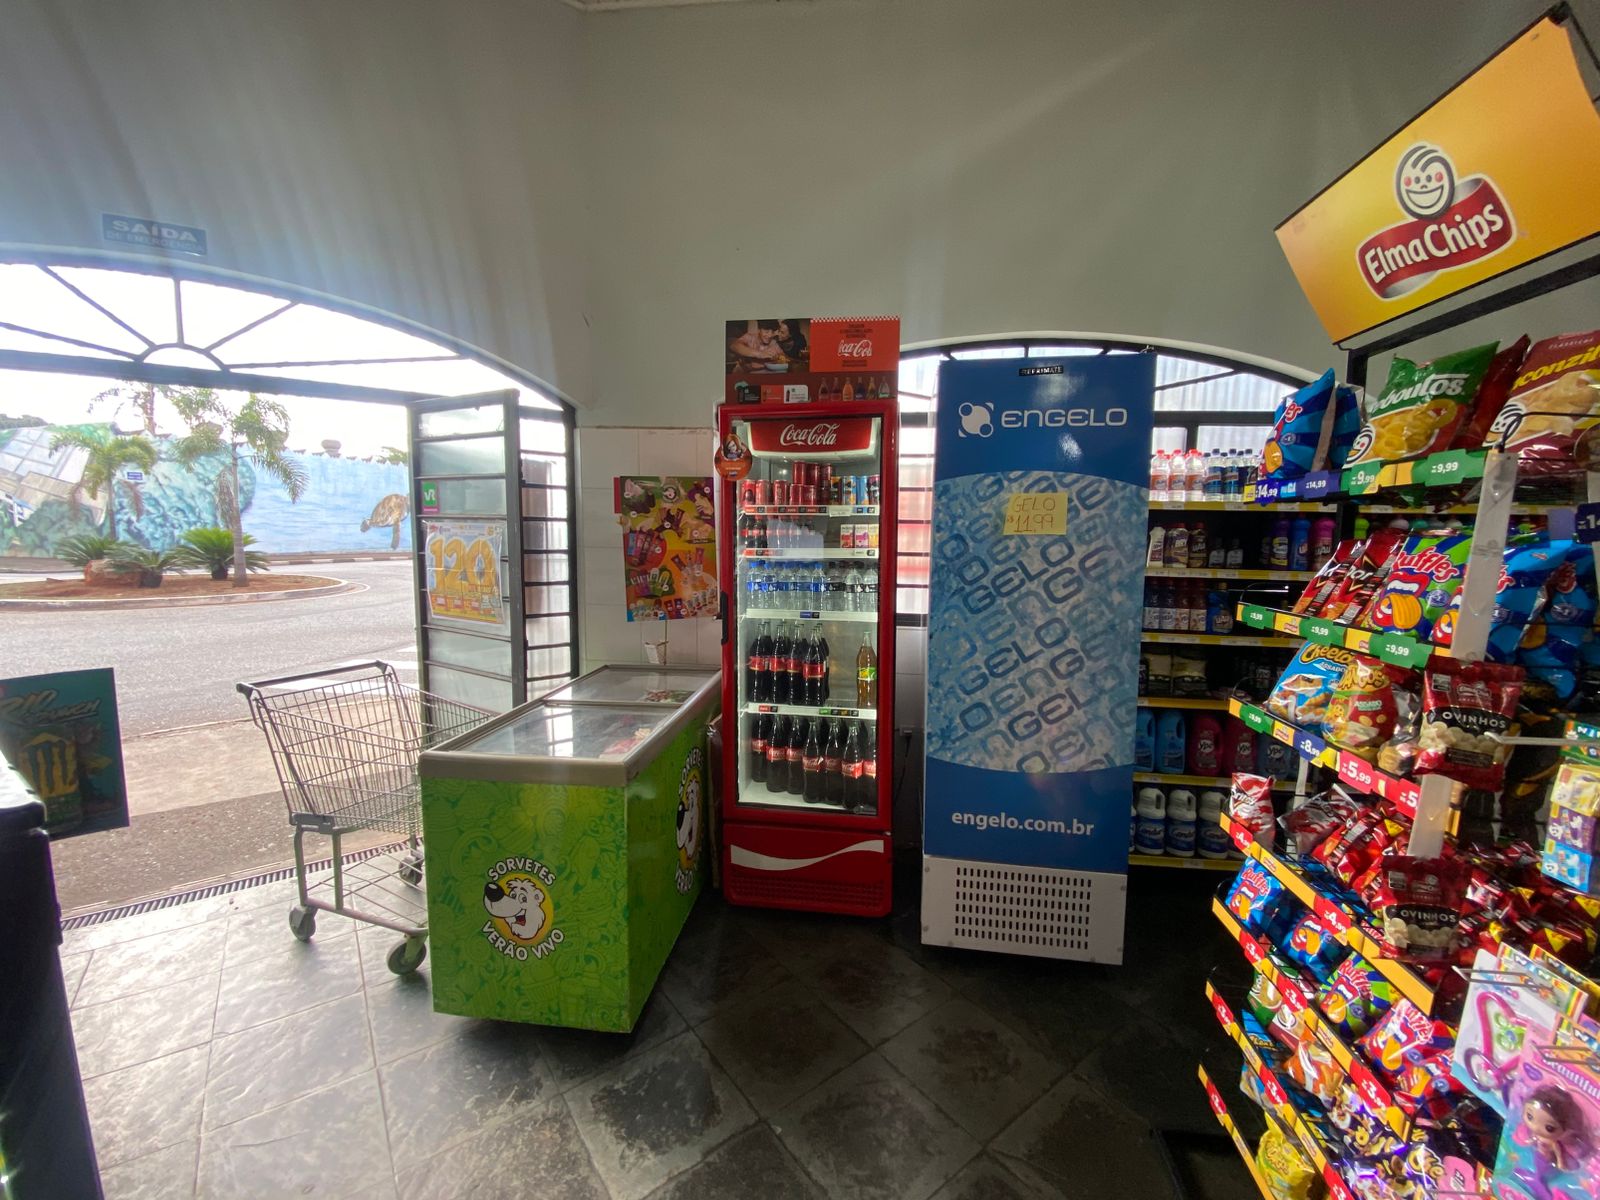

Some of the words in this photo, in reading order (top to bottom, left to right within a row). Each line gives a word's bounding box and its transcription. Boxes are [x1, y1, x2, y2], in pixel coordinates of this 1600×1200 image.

[780, 423, 841, 447] Coca-Cola
[1013, 496, 1056, 513] GELO
[429, 537, 497, 592] 120
[1442, 711, 1506, 729] OVINHOS
[1347, 761, 1372, 785] 5,99
[951, 811, 1095, 836] engelo.com.br
[488, 857, 556, 886] SORVETES
[1400, 908, 1457, 923] OVINHOS
[482, 920, 528, 961] VERÃO
[531, 929, 564, 959] VIVO
